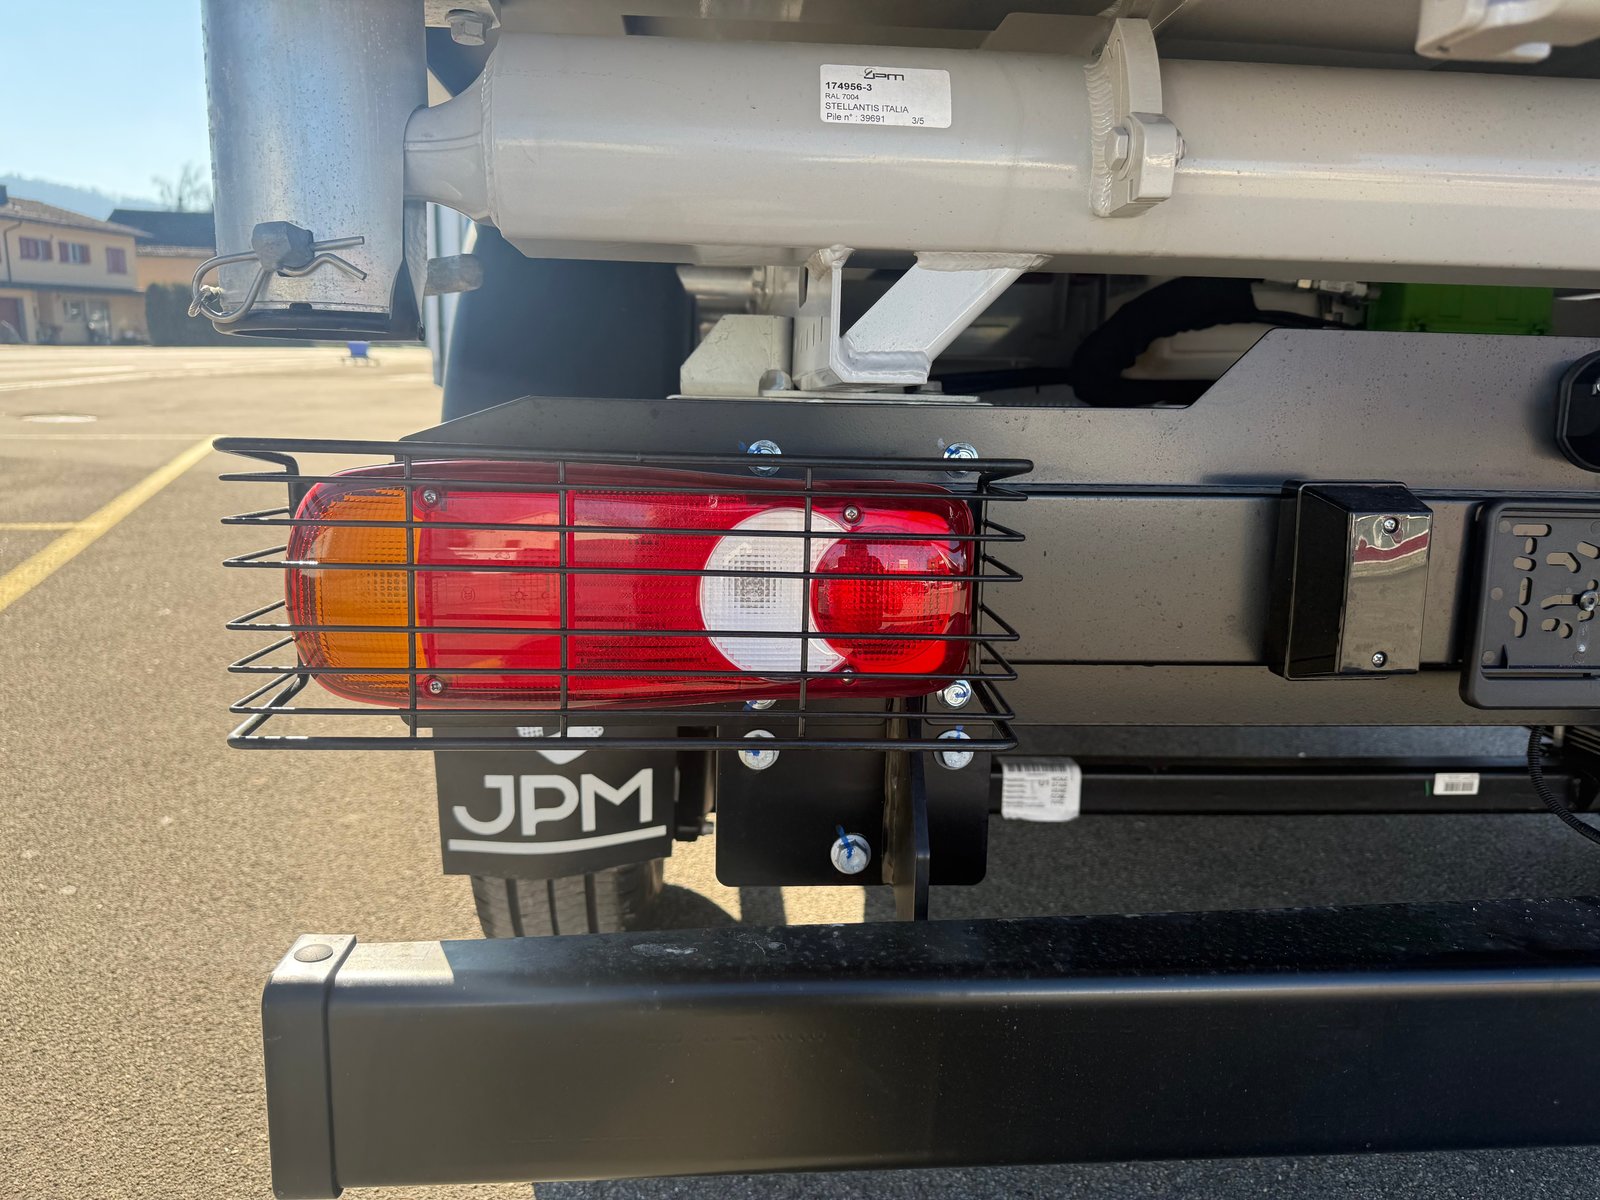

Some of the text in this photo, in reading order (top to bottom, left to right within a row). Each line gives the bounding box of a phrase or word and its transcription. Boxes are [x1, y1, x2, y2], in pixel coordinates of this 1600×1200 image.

[825, 81, 873, 91] 174956-3
[825, 92, 840, 100] RAL
[825, 102, 910, 113] STELLANTIS ITALIA
[826, 112, 842, 121] Pile
[860, 114, 886, 123] 39691
[911, 117, 925, 125] 3/5
[453, 768, 653, 836] JPM
